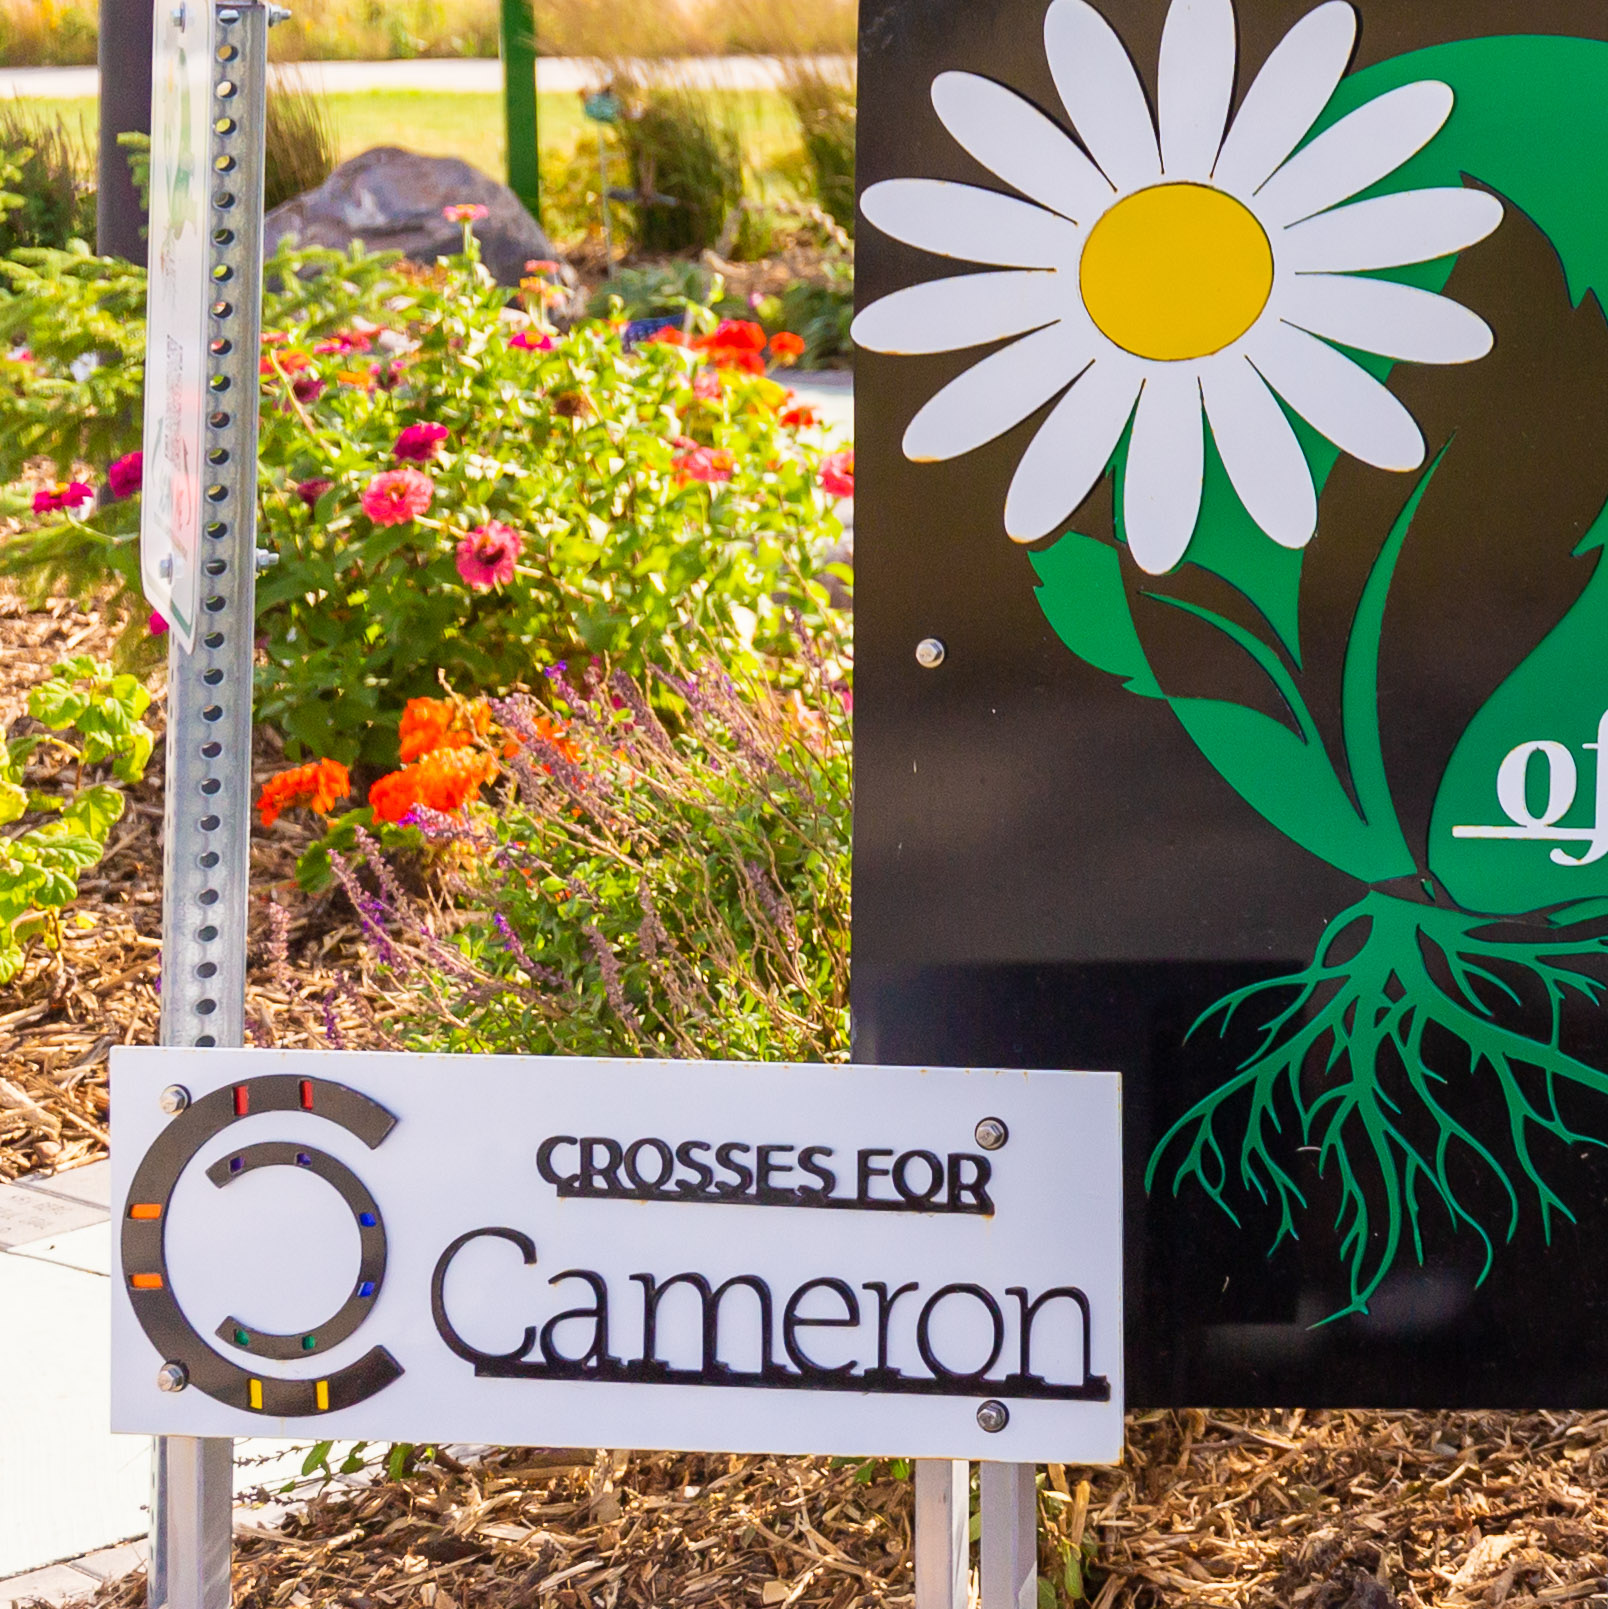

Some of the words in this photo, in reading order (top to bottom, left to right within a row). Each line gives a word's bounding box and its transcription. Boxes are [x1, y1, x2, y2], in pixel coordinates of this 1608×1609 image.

[536, 1134, 836, 1199] CROSSES
[857, 1146, 993, 1214] FOR
[431, 1225, 1110, 1401] Cameron
